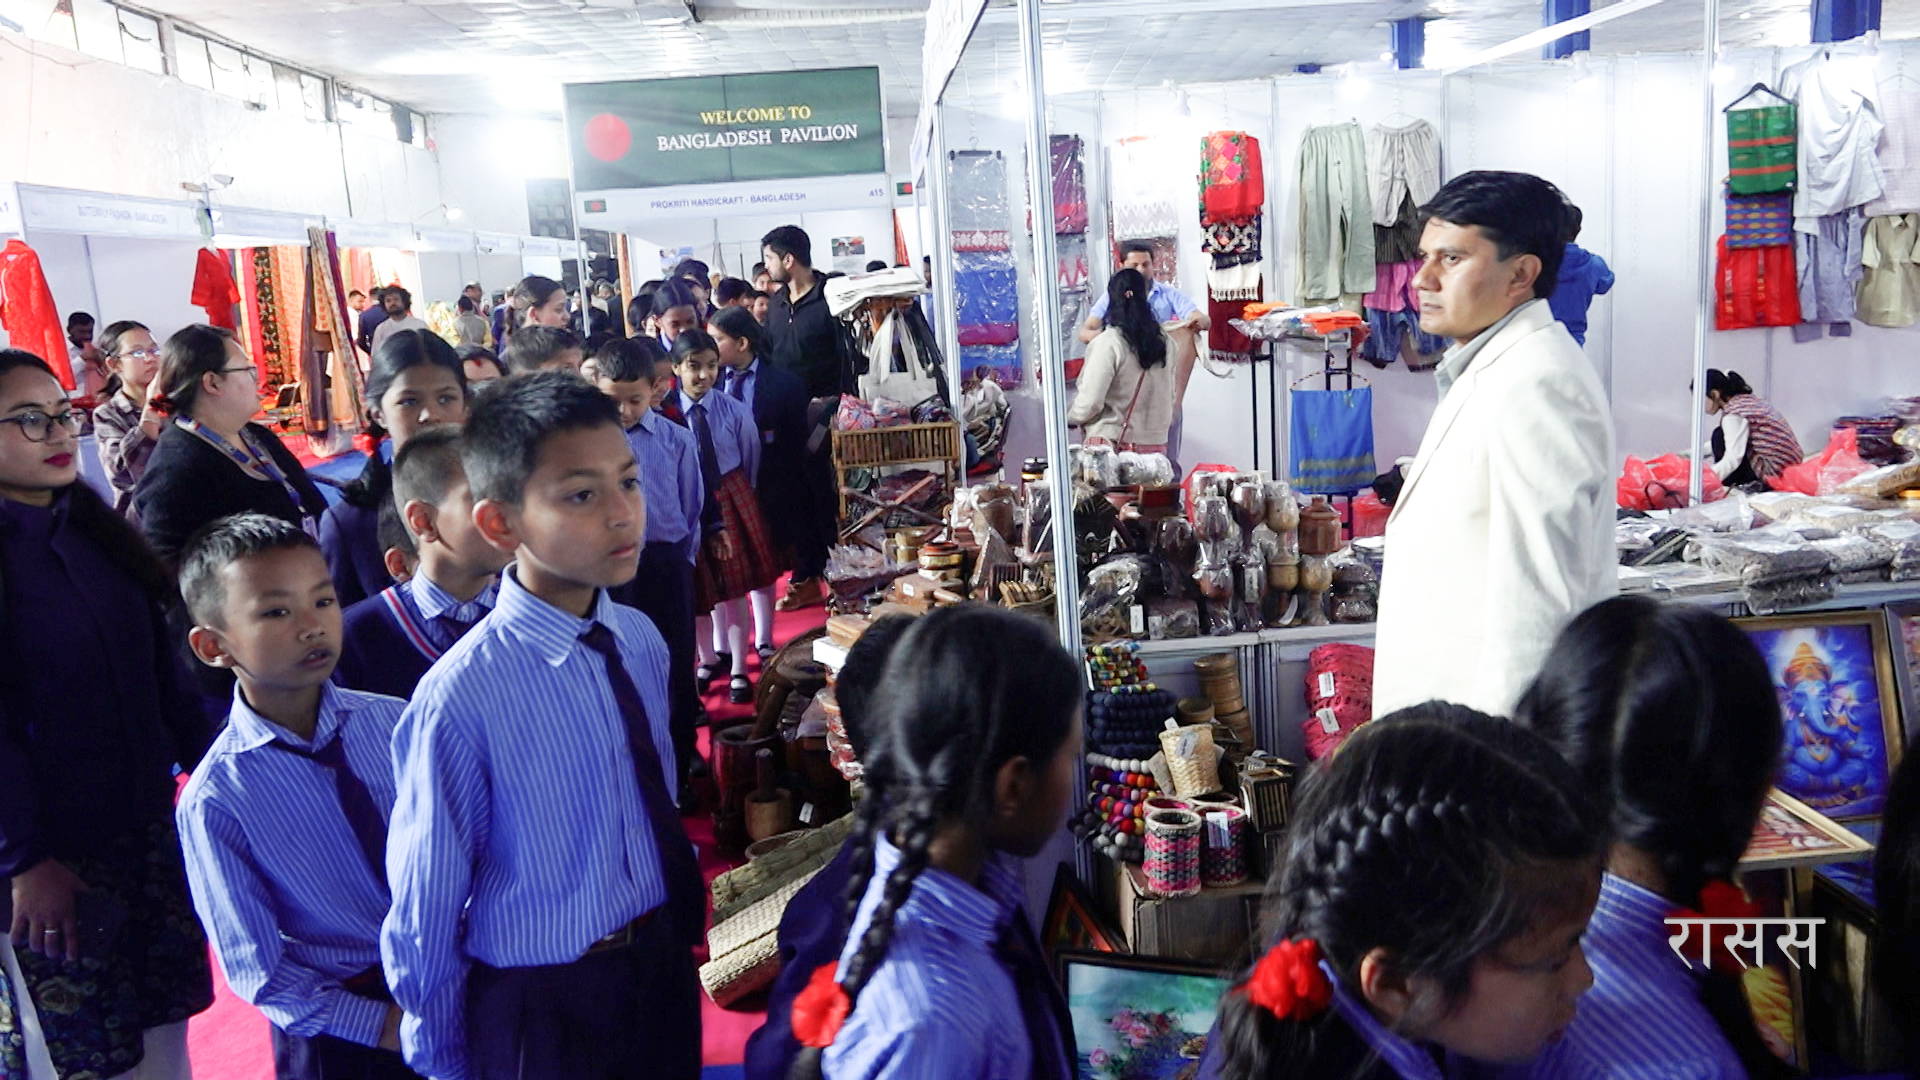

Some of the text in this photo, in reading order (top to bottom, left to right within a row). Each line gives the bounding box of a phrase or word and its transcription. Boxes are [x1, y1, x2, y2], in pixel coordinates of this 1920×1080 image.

[700, 104, 812, 125] WELCOME TO
[657, 124, 858, 151] BANGLADESH PAVILION
[650, 199, 690, 209] PROKRITI
[691, 196, 743, 207] HANDICRAFT
[750, 193, 807, 204] BANGLADESH
